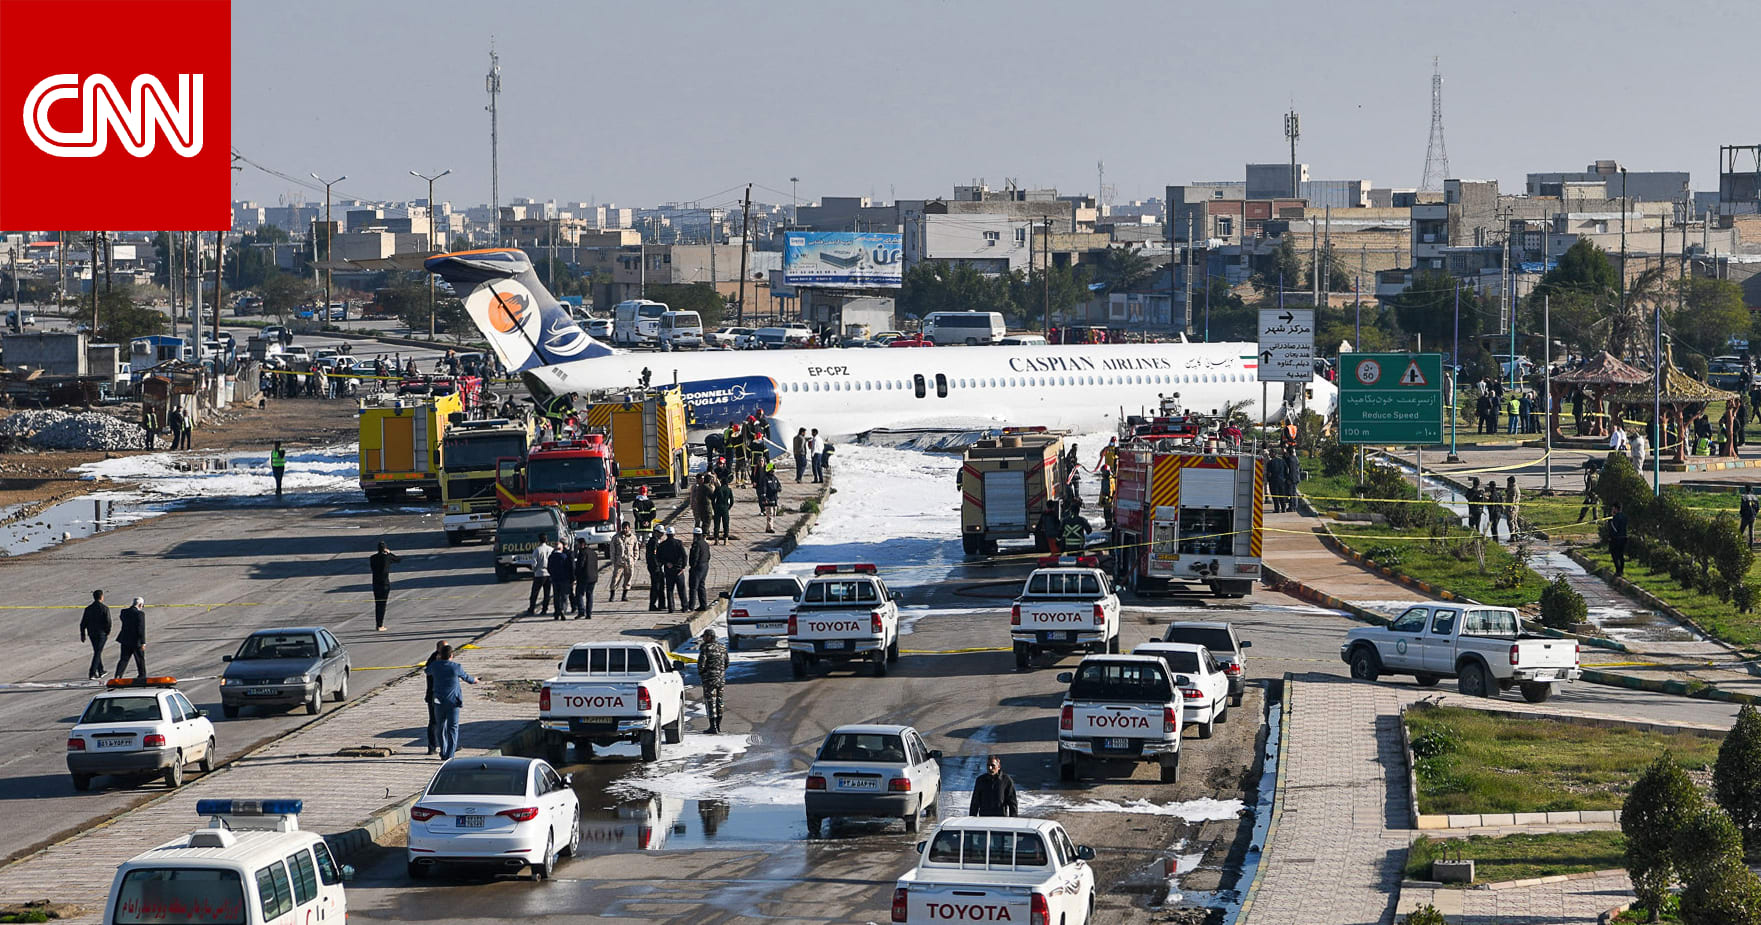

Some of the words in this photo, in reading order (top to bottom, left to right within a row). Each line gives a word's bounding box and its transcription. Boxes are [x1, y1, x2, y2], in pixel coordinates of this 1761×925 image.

[1265, 324, 1286, 335] شهر
[1287, 324, 1310, 335] مرکز
[1009, 356, 1096, 373] CASPIAN
[1102, 357, 1172, 371] AIRLINES
[808, 365, 850, 377] EP-CPZ
[1363, 372, 1374, 380] 50
[1362, 411, 1393, 419] Reduce
[1393, 411, 1419, 420] Speed
[1344, 428, 1360, 436] 100
[502, 541, 540, 553] FOLLOW
[1032, 612, 1083, 623] TOYOTA
[808, 621, 860, 632] TOYOTA
[563, 696, 624, 708] TOYOTA
[1087, 715, 1150, 728] TOYOTA
[926, 903, 1012, 921] TOYOTA
